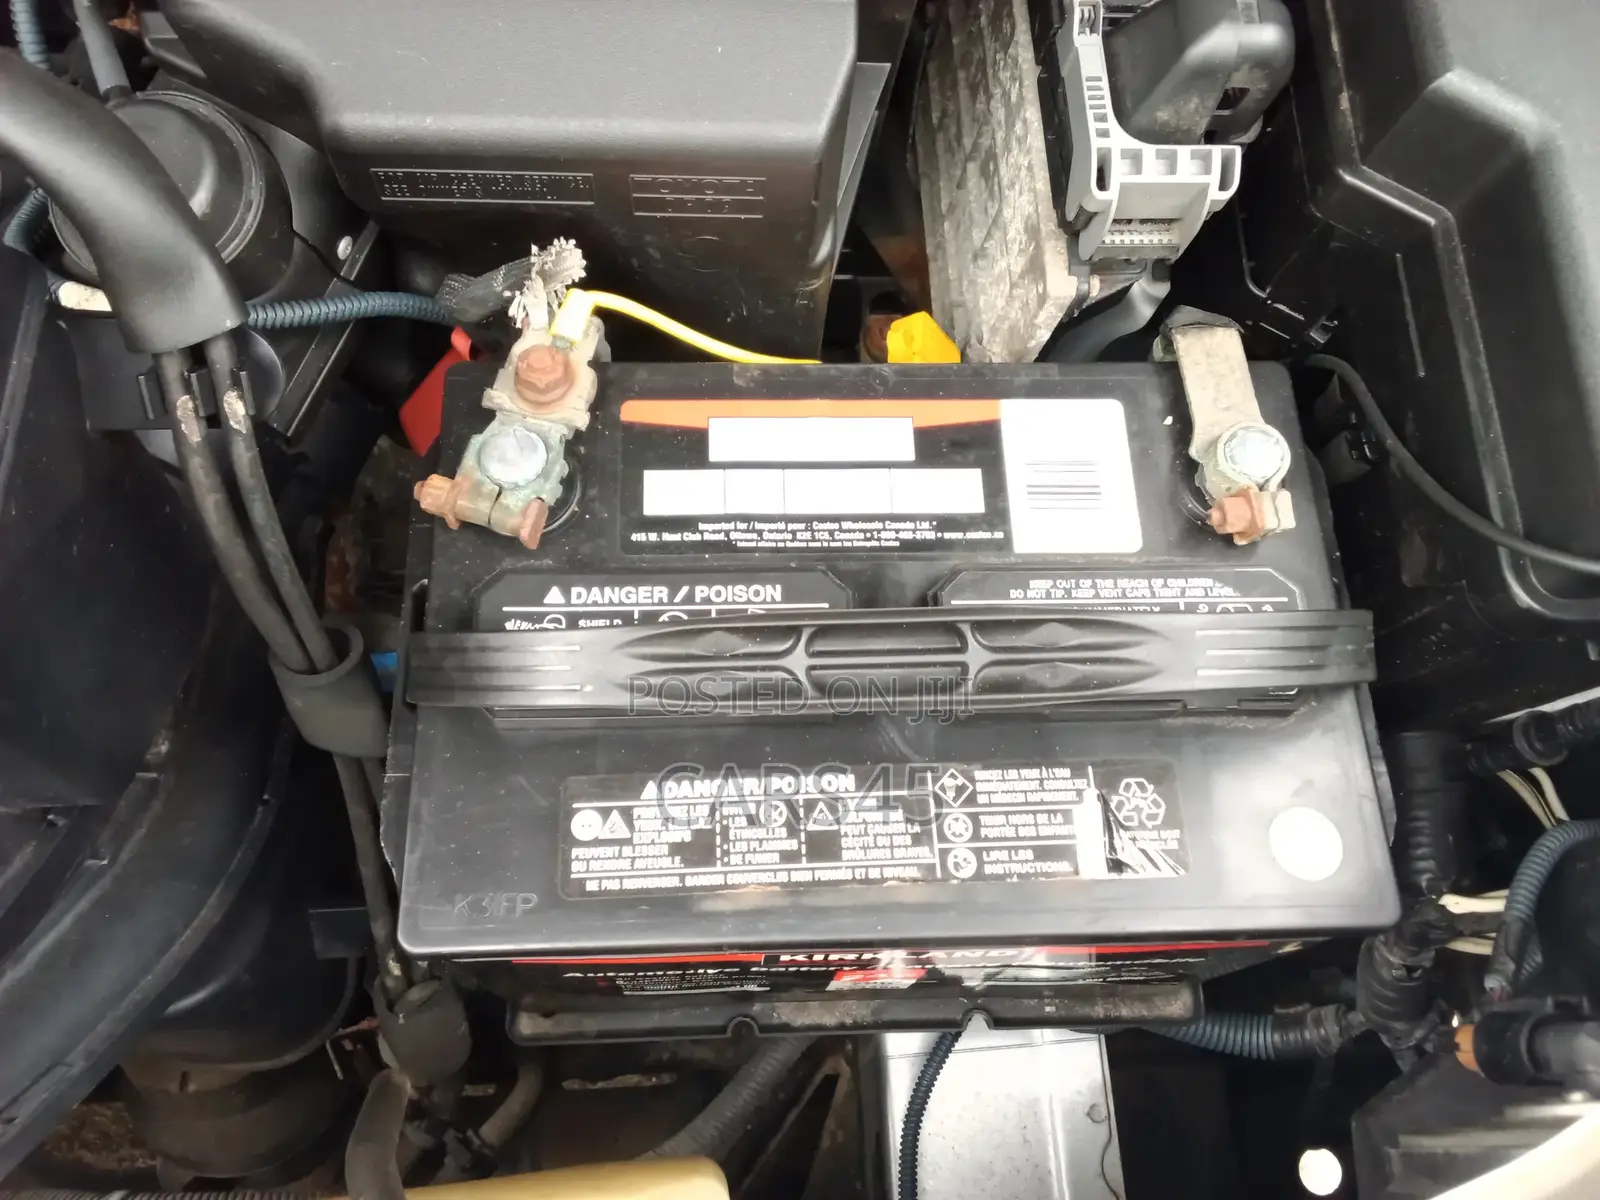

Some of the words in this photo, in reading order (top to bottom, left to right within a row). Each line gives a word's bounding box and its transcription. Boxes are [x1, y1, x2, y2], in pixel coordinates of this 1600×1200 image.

[1056, 580, 1076, 589] OUT
[1079, 579, 1094, 589] OF
[1095, 579, 1116, 588] THE
[1117, 579, 1149, 588] REACH
[1151, 578, 1166, 587] OF
[570, 586, 668, 604] DANGER
[673, 586, 690, 604] /
[695, 584, 783, 603] POISON
[1009, 590, 1025, 599] DO
[1026, 590, 1047, 599] NOT
[1048, 589, 1068, 599] TIP.
[1071, 589, 1096, 598] KEEP
[1099, 589, 1124, 598] VENT
[1126, 588, 1152, 598] CAPS
[840, 823, 867, 837] PEUT
[571, 846, 621, 860] PEUVENT
[729, 841, 749, 853] LES
[571, 860, 588, 873] OU
